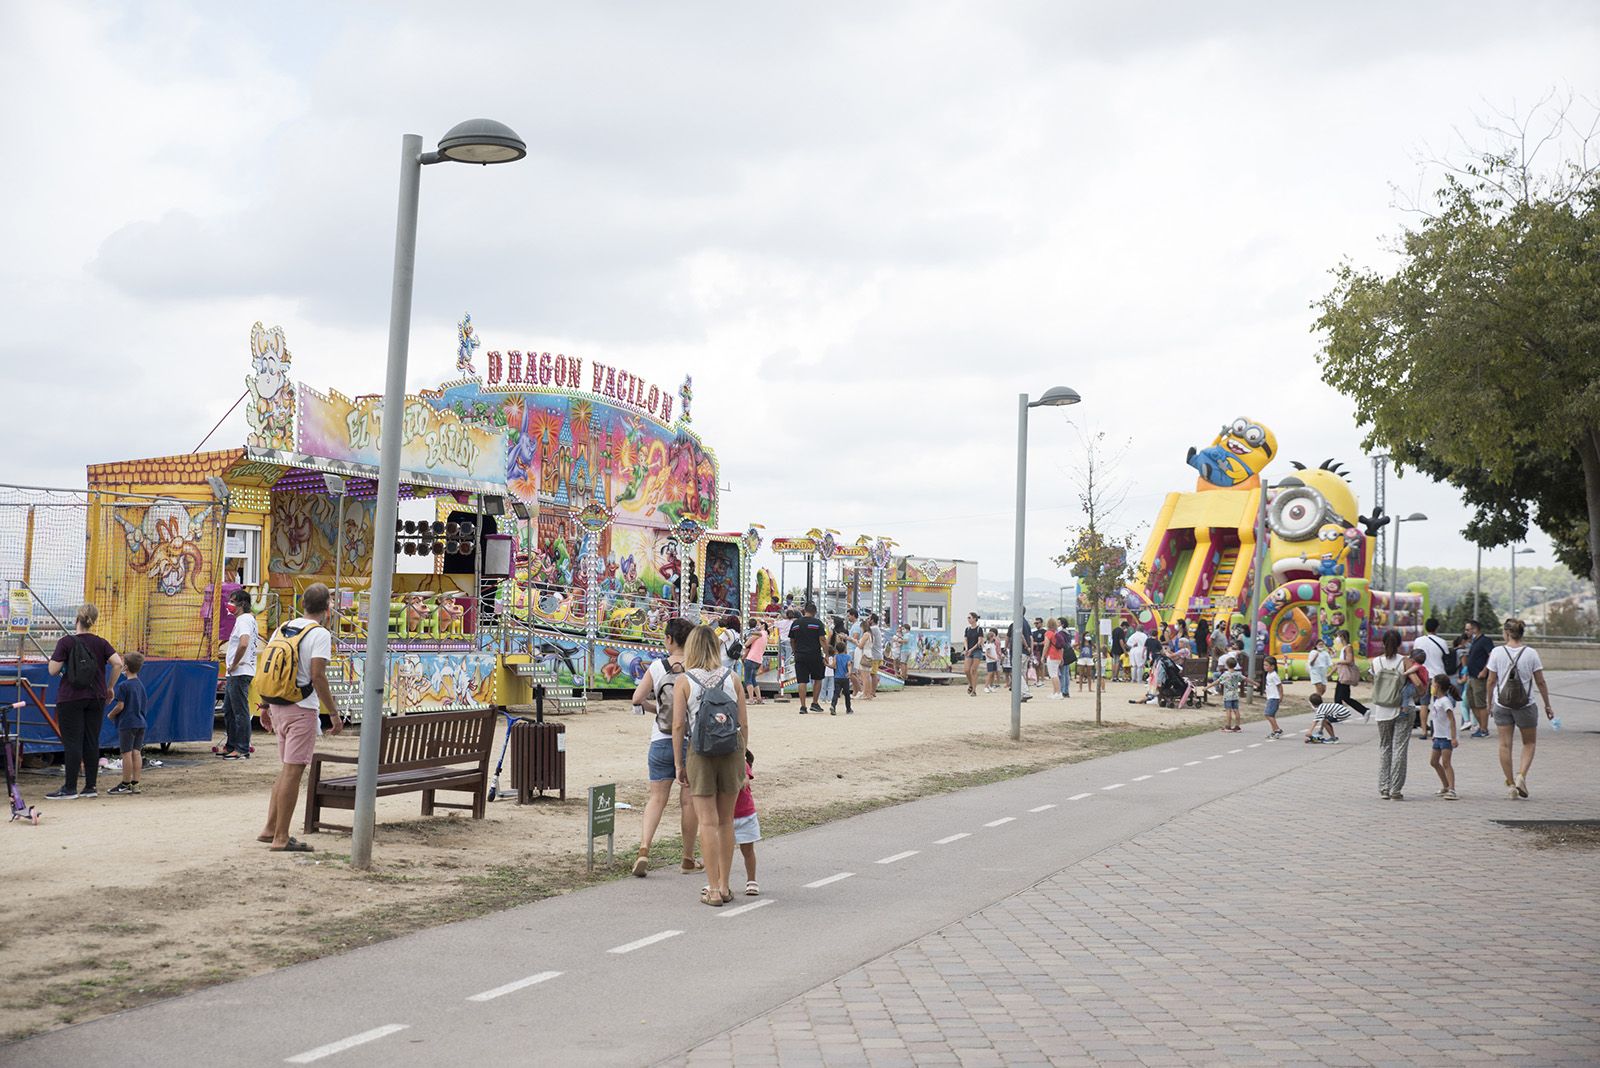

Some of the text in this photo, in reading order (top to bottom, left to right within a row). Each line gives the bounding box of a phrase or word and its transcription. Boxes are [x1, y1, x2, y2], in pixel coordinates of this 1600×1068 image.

[487, 350, 674, 423] DRAGON VACILON
[347, 403, 430, 451] EL TITO
[775, 541, 812, 549] ENTRADA
